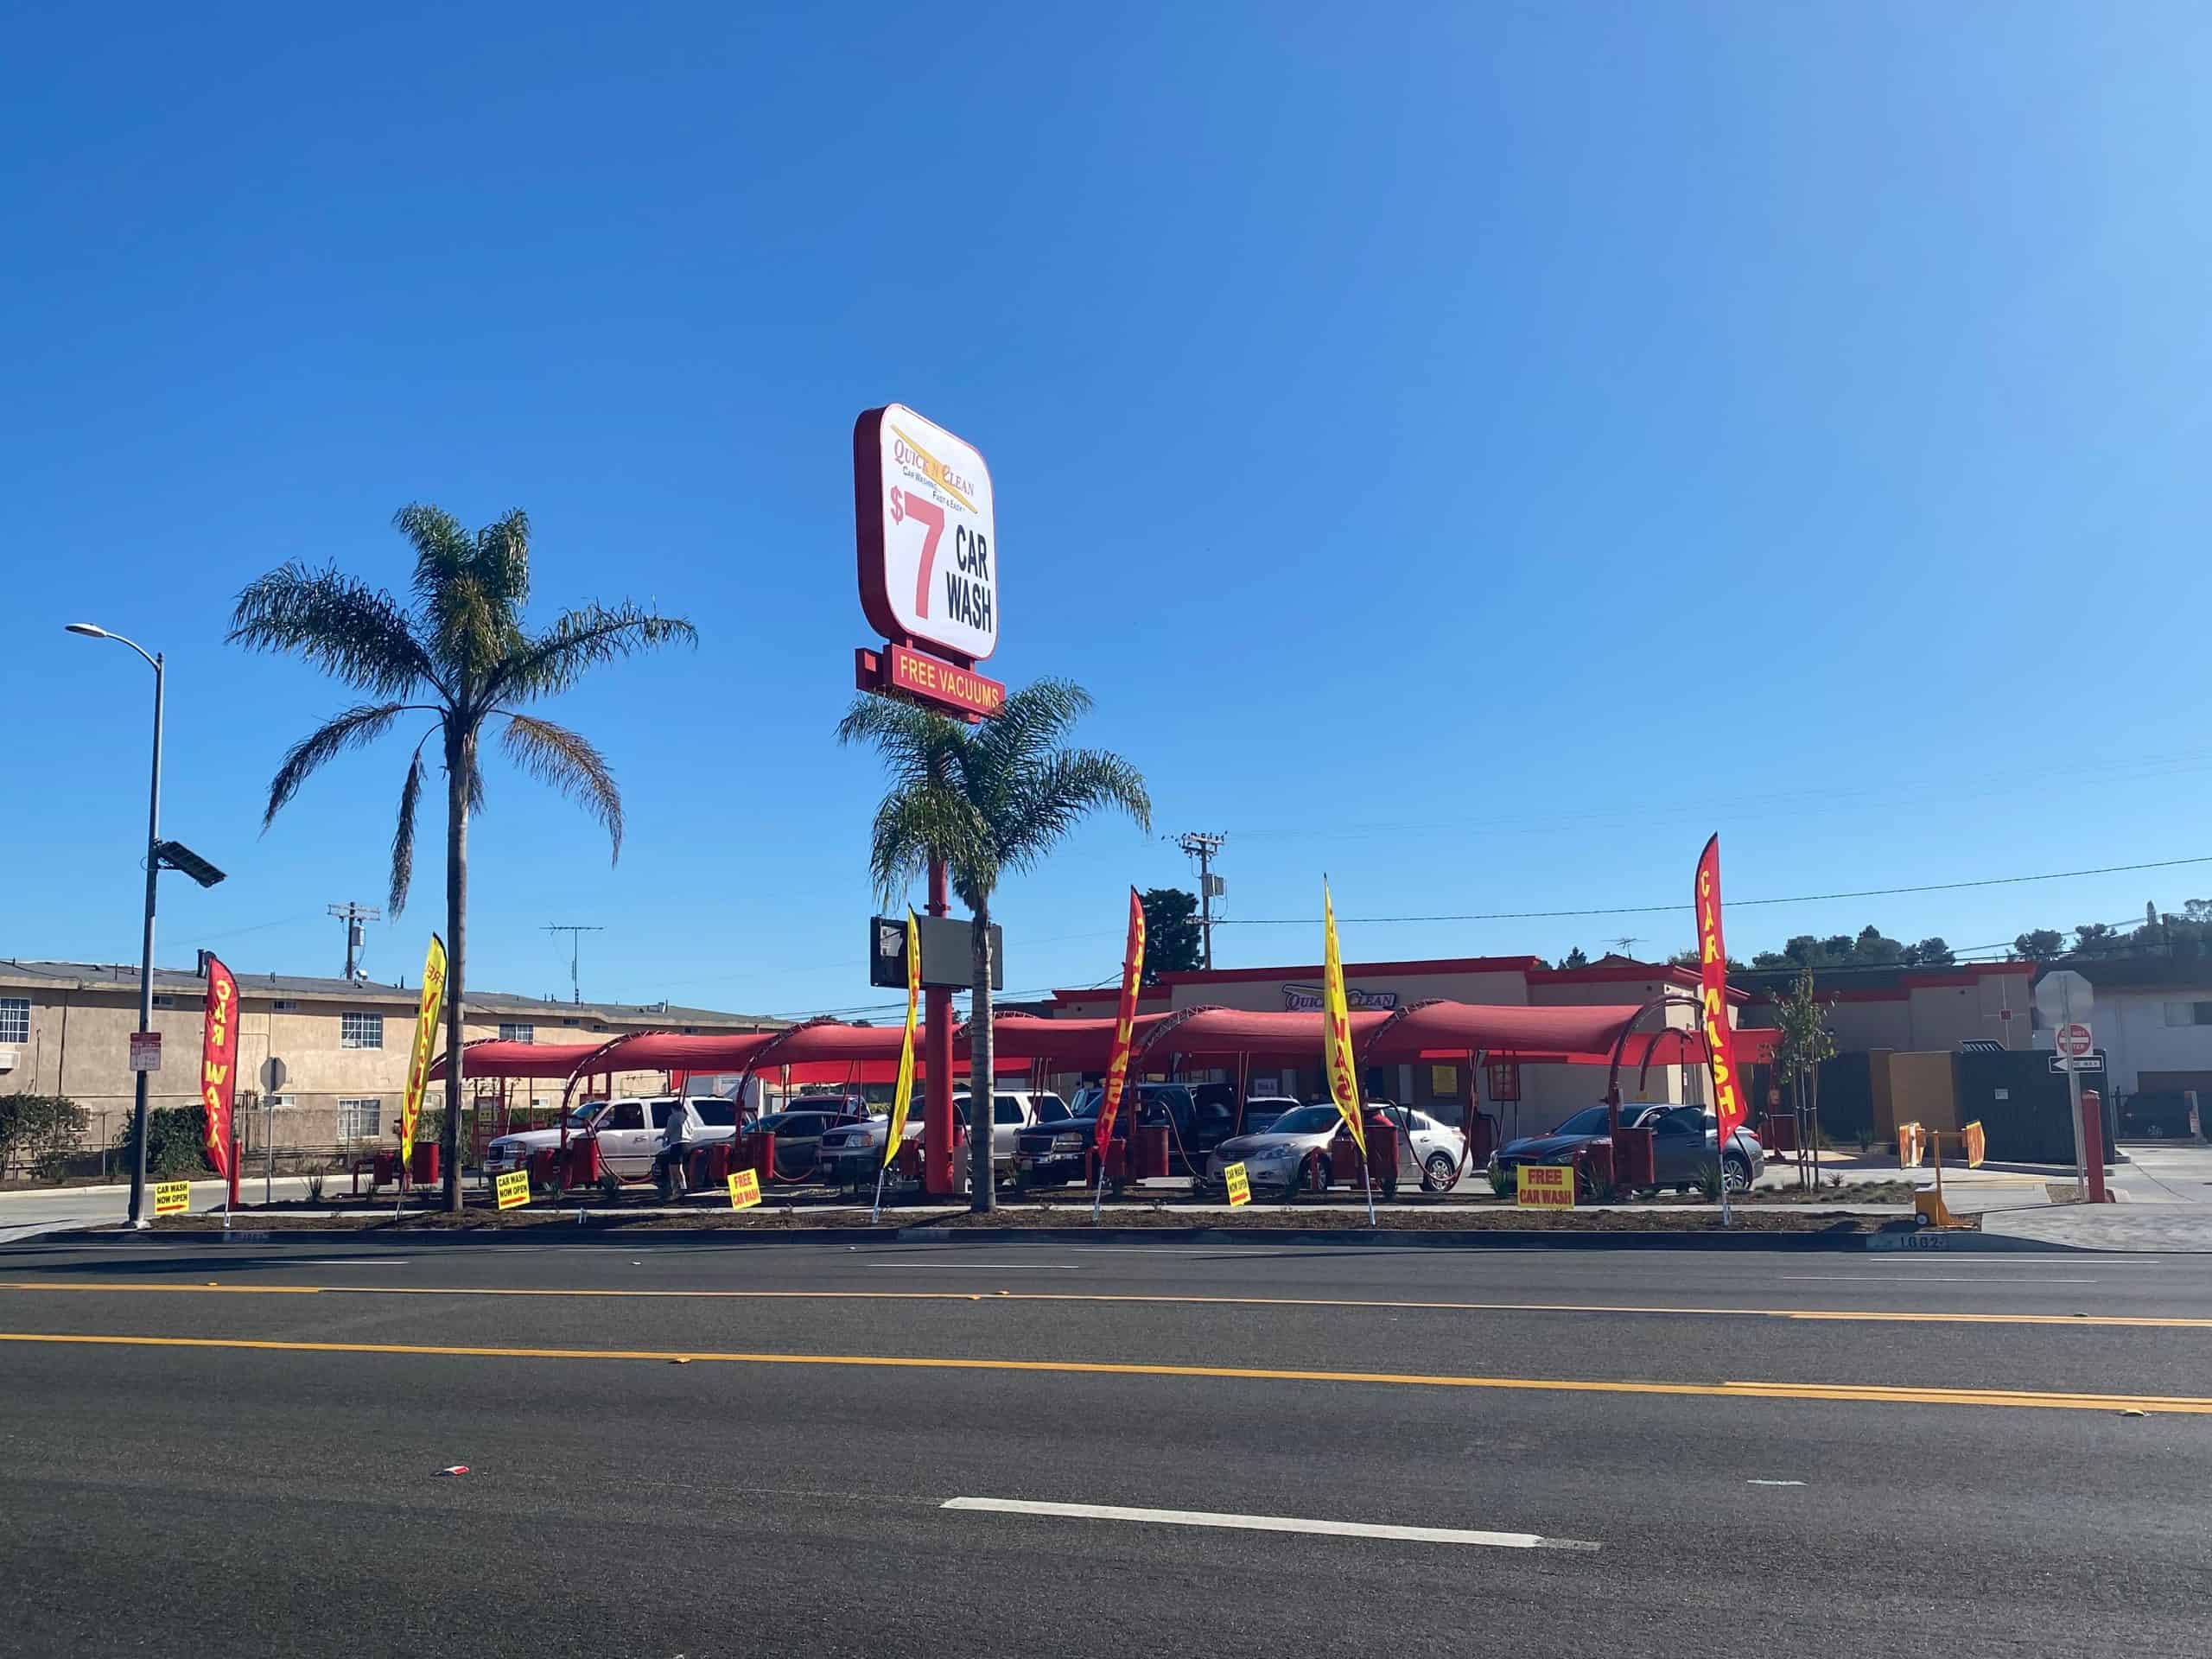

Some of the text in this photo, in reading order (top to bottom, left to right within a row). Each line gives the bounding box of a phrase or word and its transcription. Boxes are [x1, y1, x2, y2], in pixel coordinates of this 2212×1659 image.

[894, 439, 928, 474] QUICK
[942, 464, 974, 498] CLEAN
[956, 524, 988, 582] CAR
[946, 570, 991, 634] WASH
[900, 655, 1000, 709] FREE VACUUMS
[1700, 870, 1720, 964] CAR
[1286, 991, 1394, 1011] QUIC CLEAN
[499, 1173, 526, 1187] CAR WASH
[734, 1172, 753, 1189] FREE
[1528, 1168, 1562, 1185] FREE
[156, 1183, 188, 1194] CAR WASH
[499, 1185, 527, 1198] NOW OPEN
[733, 1188, 760, 1205] CAR WASH
[1520, 1188, 1572, 1205] CAR WASH
[172, 1194, 188, 1203] OPEN
